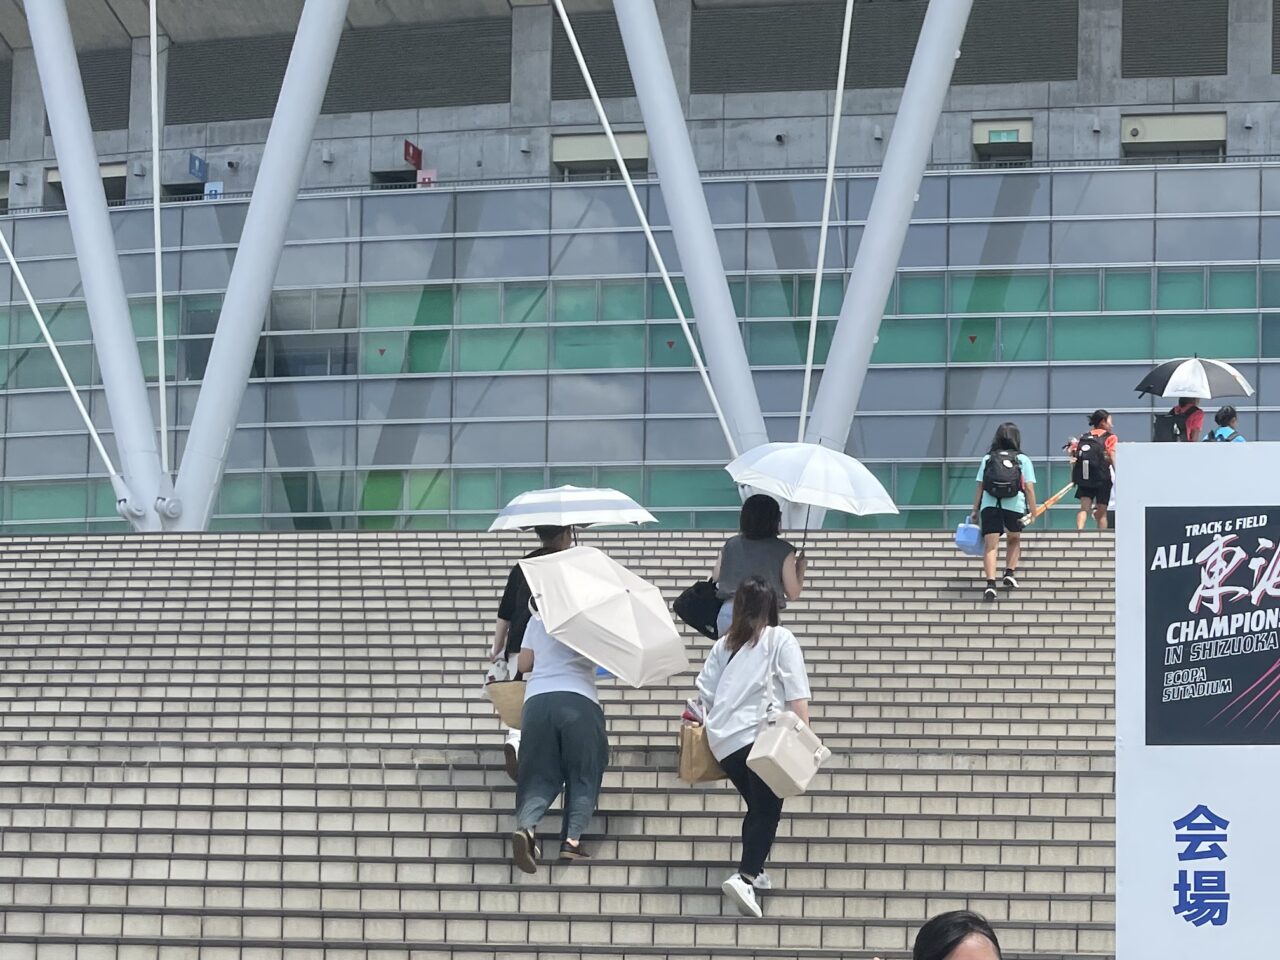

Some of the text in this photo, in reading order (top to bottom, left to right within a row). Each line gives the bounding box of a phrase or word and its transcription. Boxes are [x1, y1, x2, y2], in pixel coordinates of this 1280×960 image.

[1185, 515, 1268, 537] TRACK & FIELD
[1150, 543, 1194, 571] ALL
[1164, 631, 1279, 665] IN SHIZUOKA
[1164, 667, 1207, 686] ECOPA
[1162, 679, 1233, 702] SUTADIUM
[1172, 804, 1231, 927] 会場
